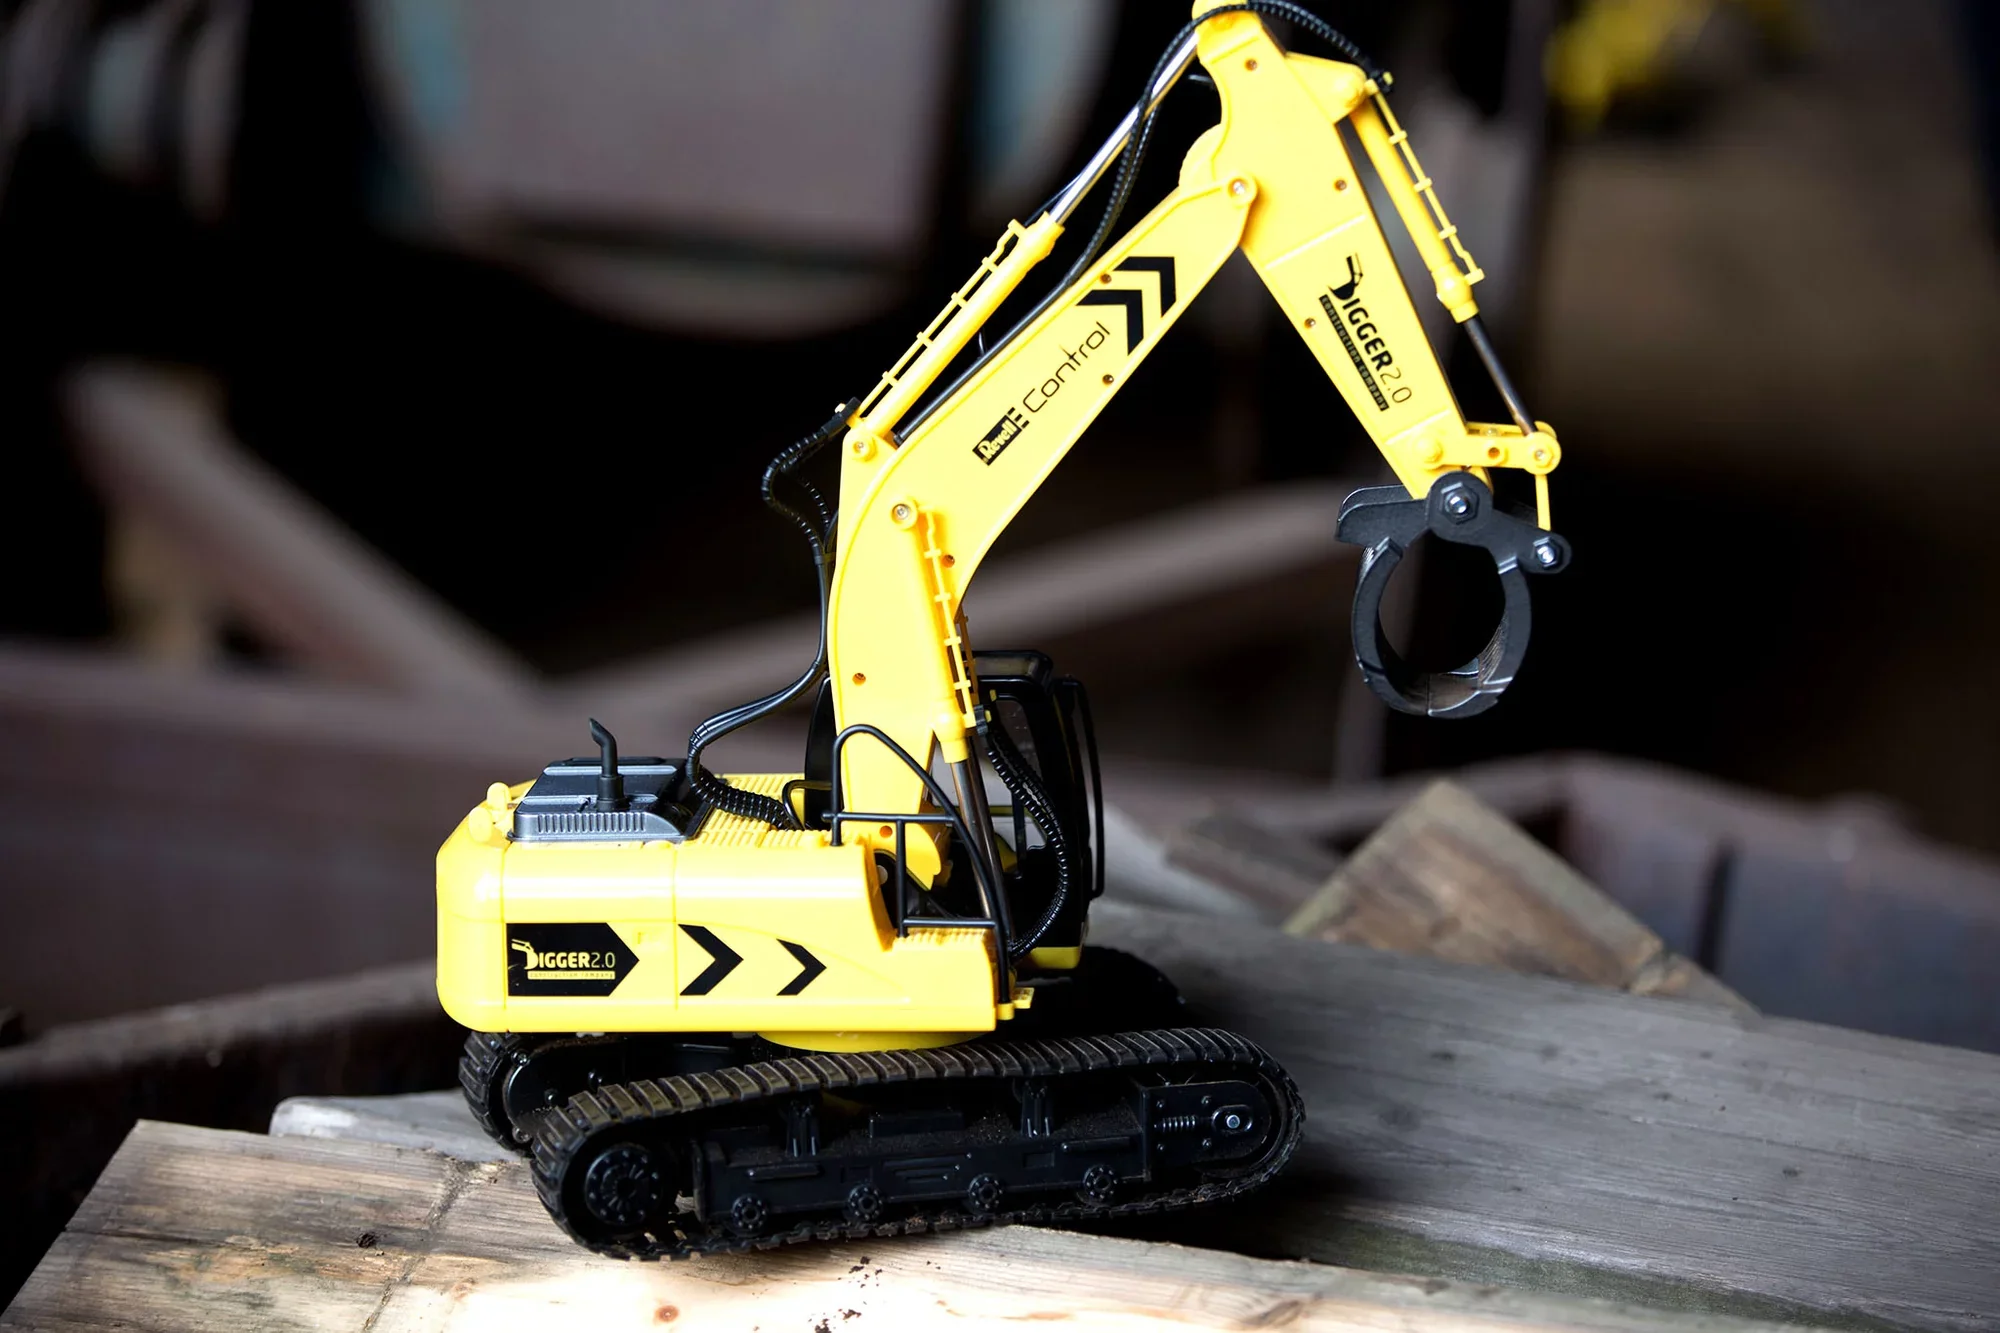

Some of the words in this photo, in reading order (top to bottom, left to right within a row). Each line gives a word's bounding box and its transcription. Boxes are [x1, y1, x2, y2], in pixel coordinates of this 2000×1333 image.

[977, 419, 1018, 460] Revell
[1023, 321, 1110, 413] Control
[1321, 296, 1361, 363] construction
[1358, 364, 1388, 410] company
